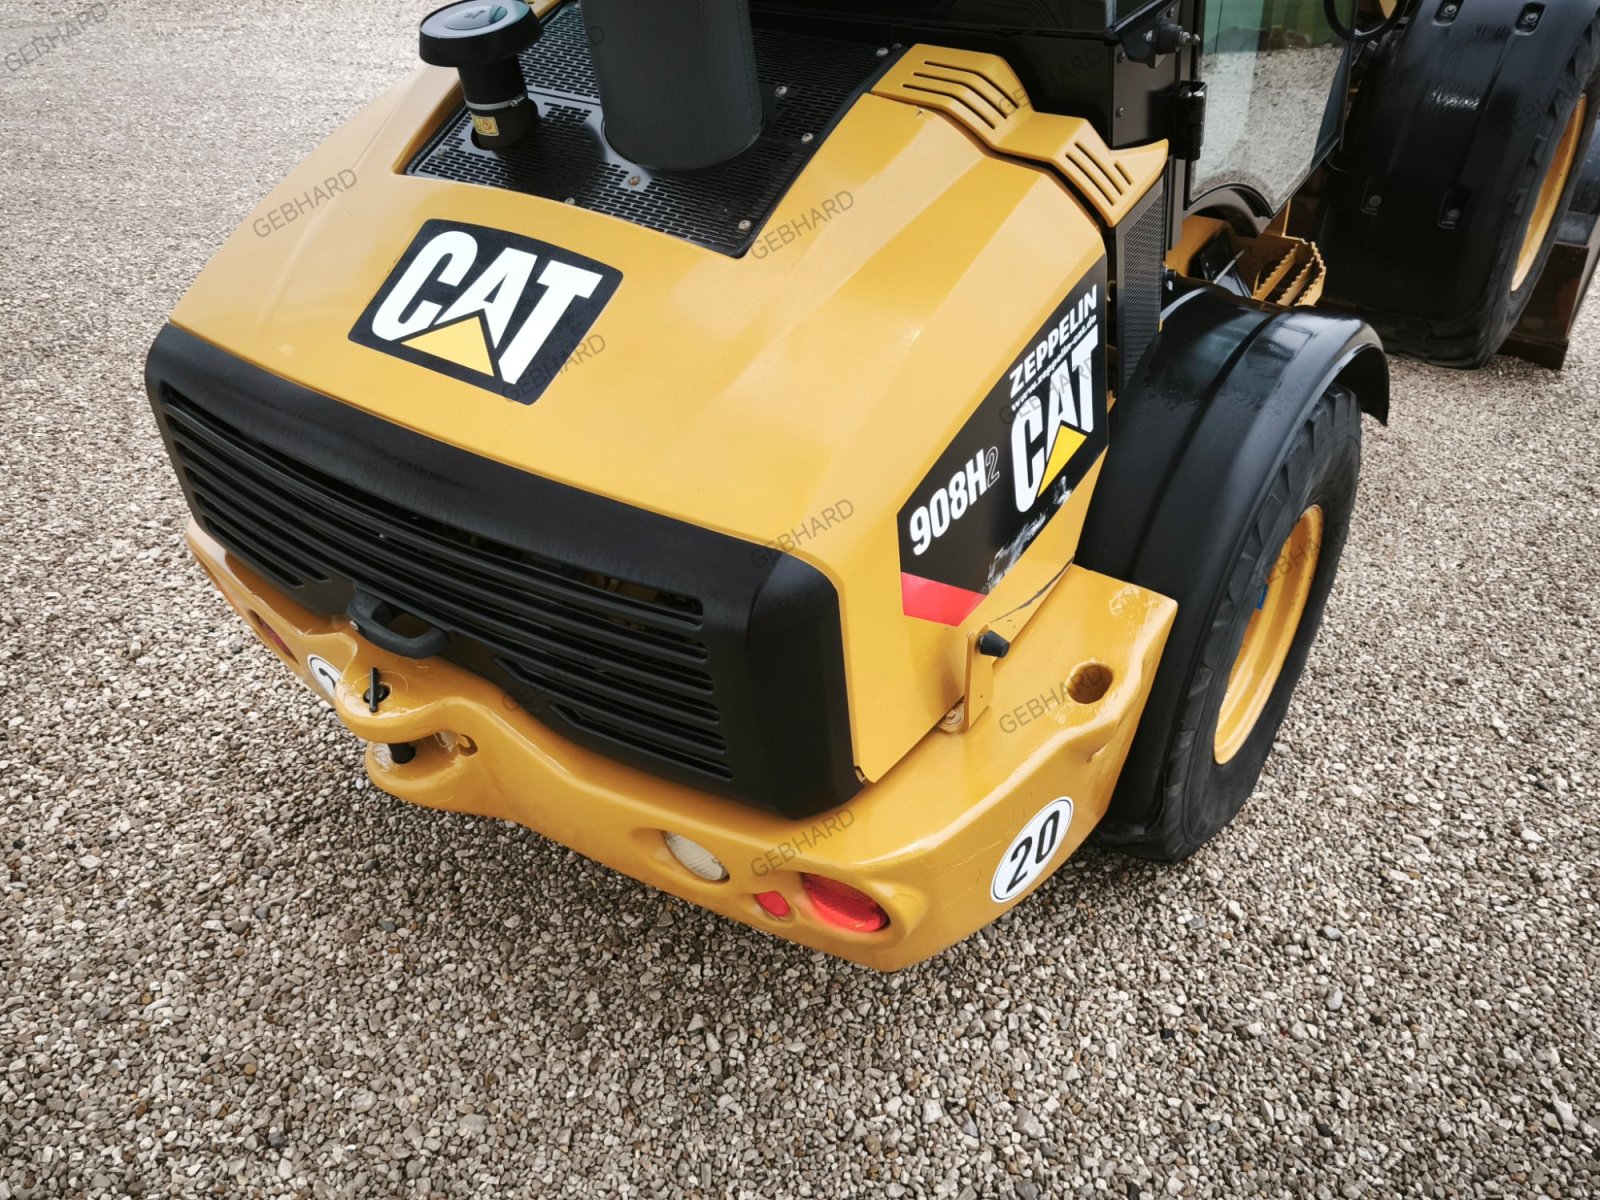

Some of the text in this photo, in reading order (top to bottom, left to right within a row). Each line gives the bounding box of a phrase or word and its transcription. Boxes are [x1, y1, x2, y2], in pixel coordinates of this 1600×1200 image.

[371, 230, 603, 385] CAT
[1009, 283, 1098, 399] ZEPPELIN
[1011, 323, 1099, 512] CAT
[1006, 810, 1060, 893] 20
